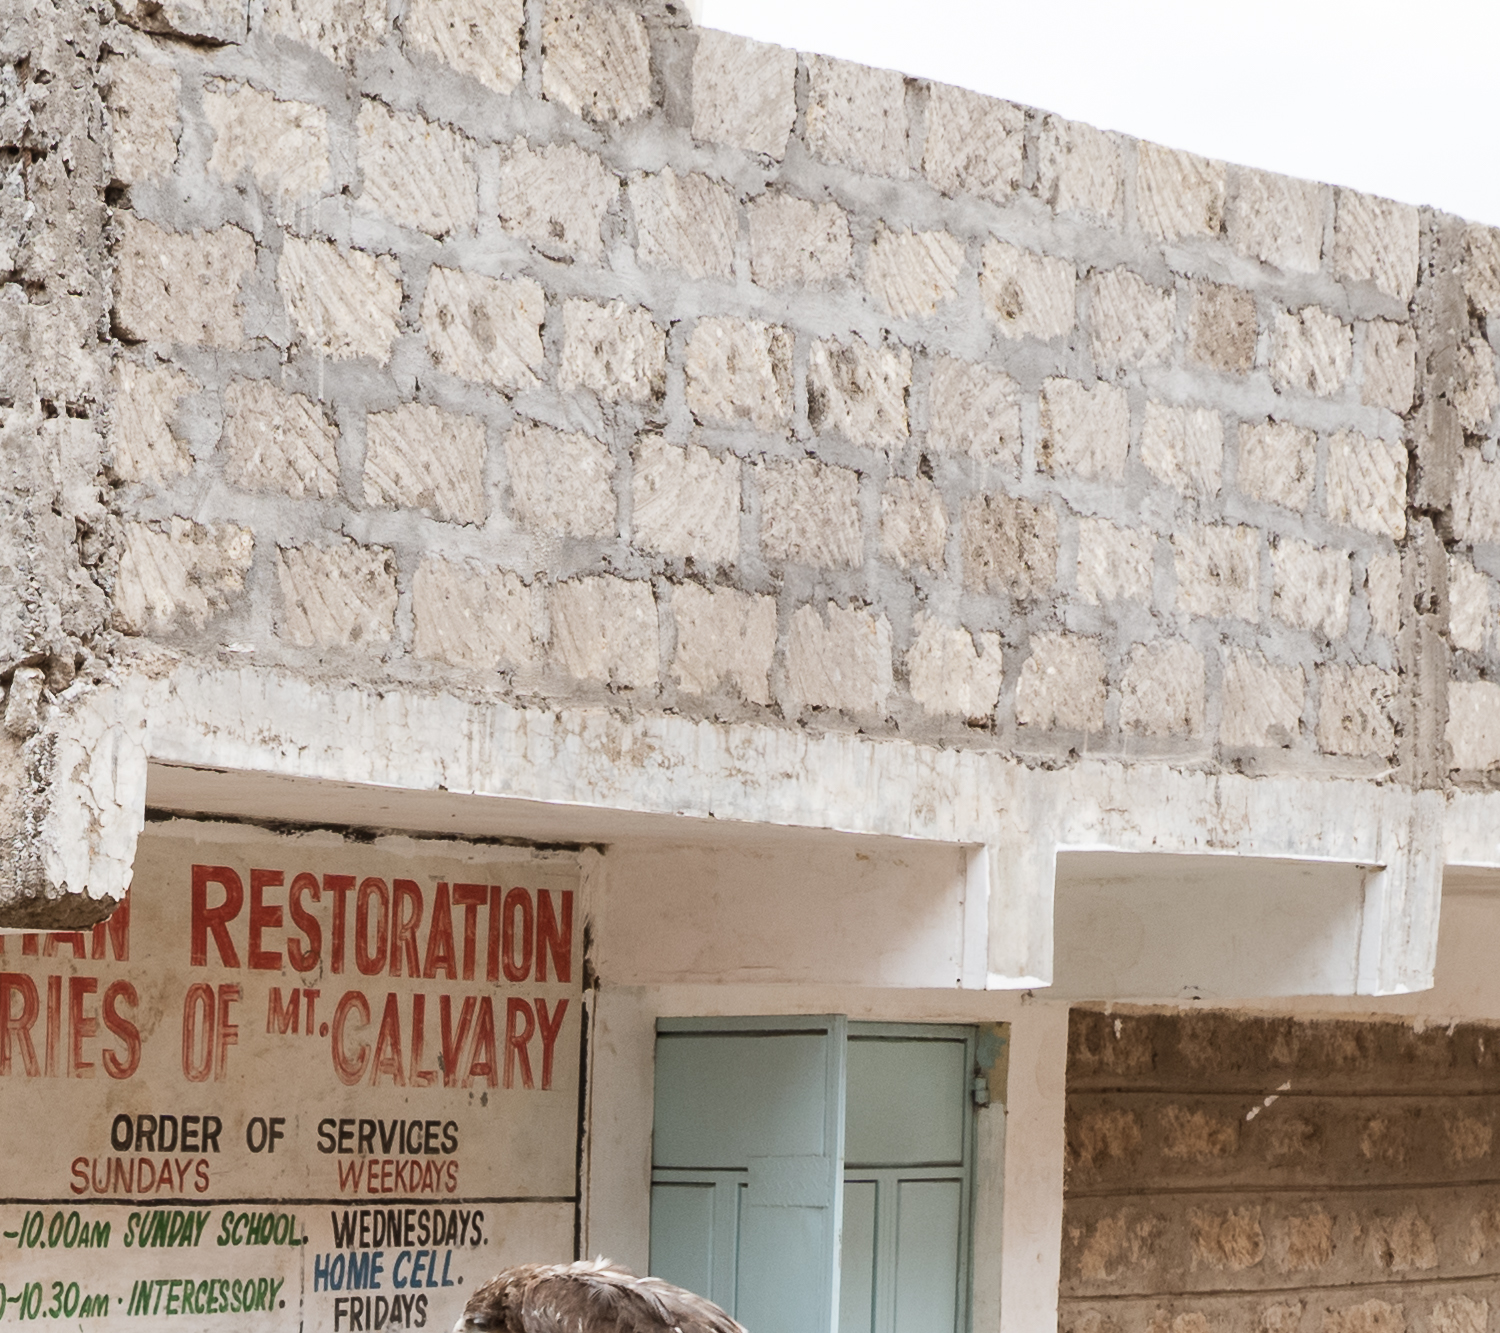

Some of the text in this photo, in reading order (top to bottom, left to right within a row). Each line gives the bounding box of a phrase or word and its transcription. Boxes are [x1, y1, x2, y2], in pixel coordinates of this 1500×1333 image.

[190, 864, 574, 984] RESTORATION
[181, 982, 240, 1083] OF
[331, 989, 570, 1091] CALVARY
[110, 1113, 459, 1155] ORDER OF SERVICES
[69, 1156, 210, 1195] SUNDAYS
[337, 1158, 459, 1195] WEEKDAYS
[123, 1210, 211, 1248] SUNDAY
[313, 1251, 384, 1292] HOME
[334, 1293, 428, 1332] FRIDAYS
